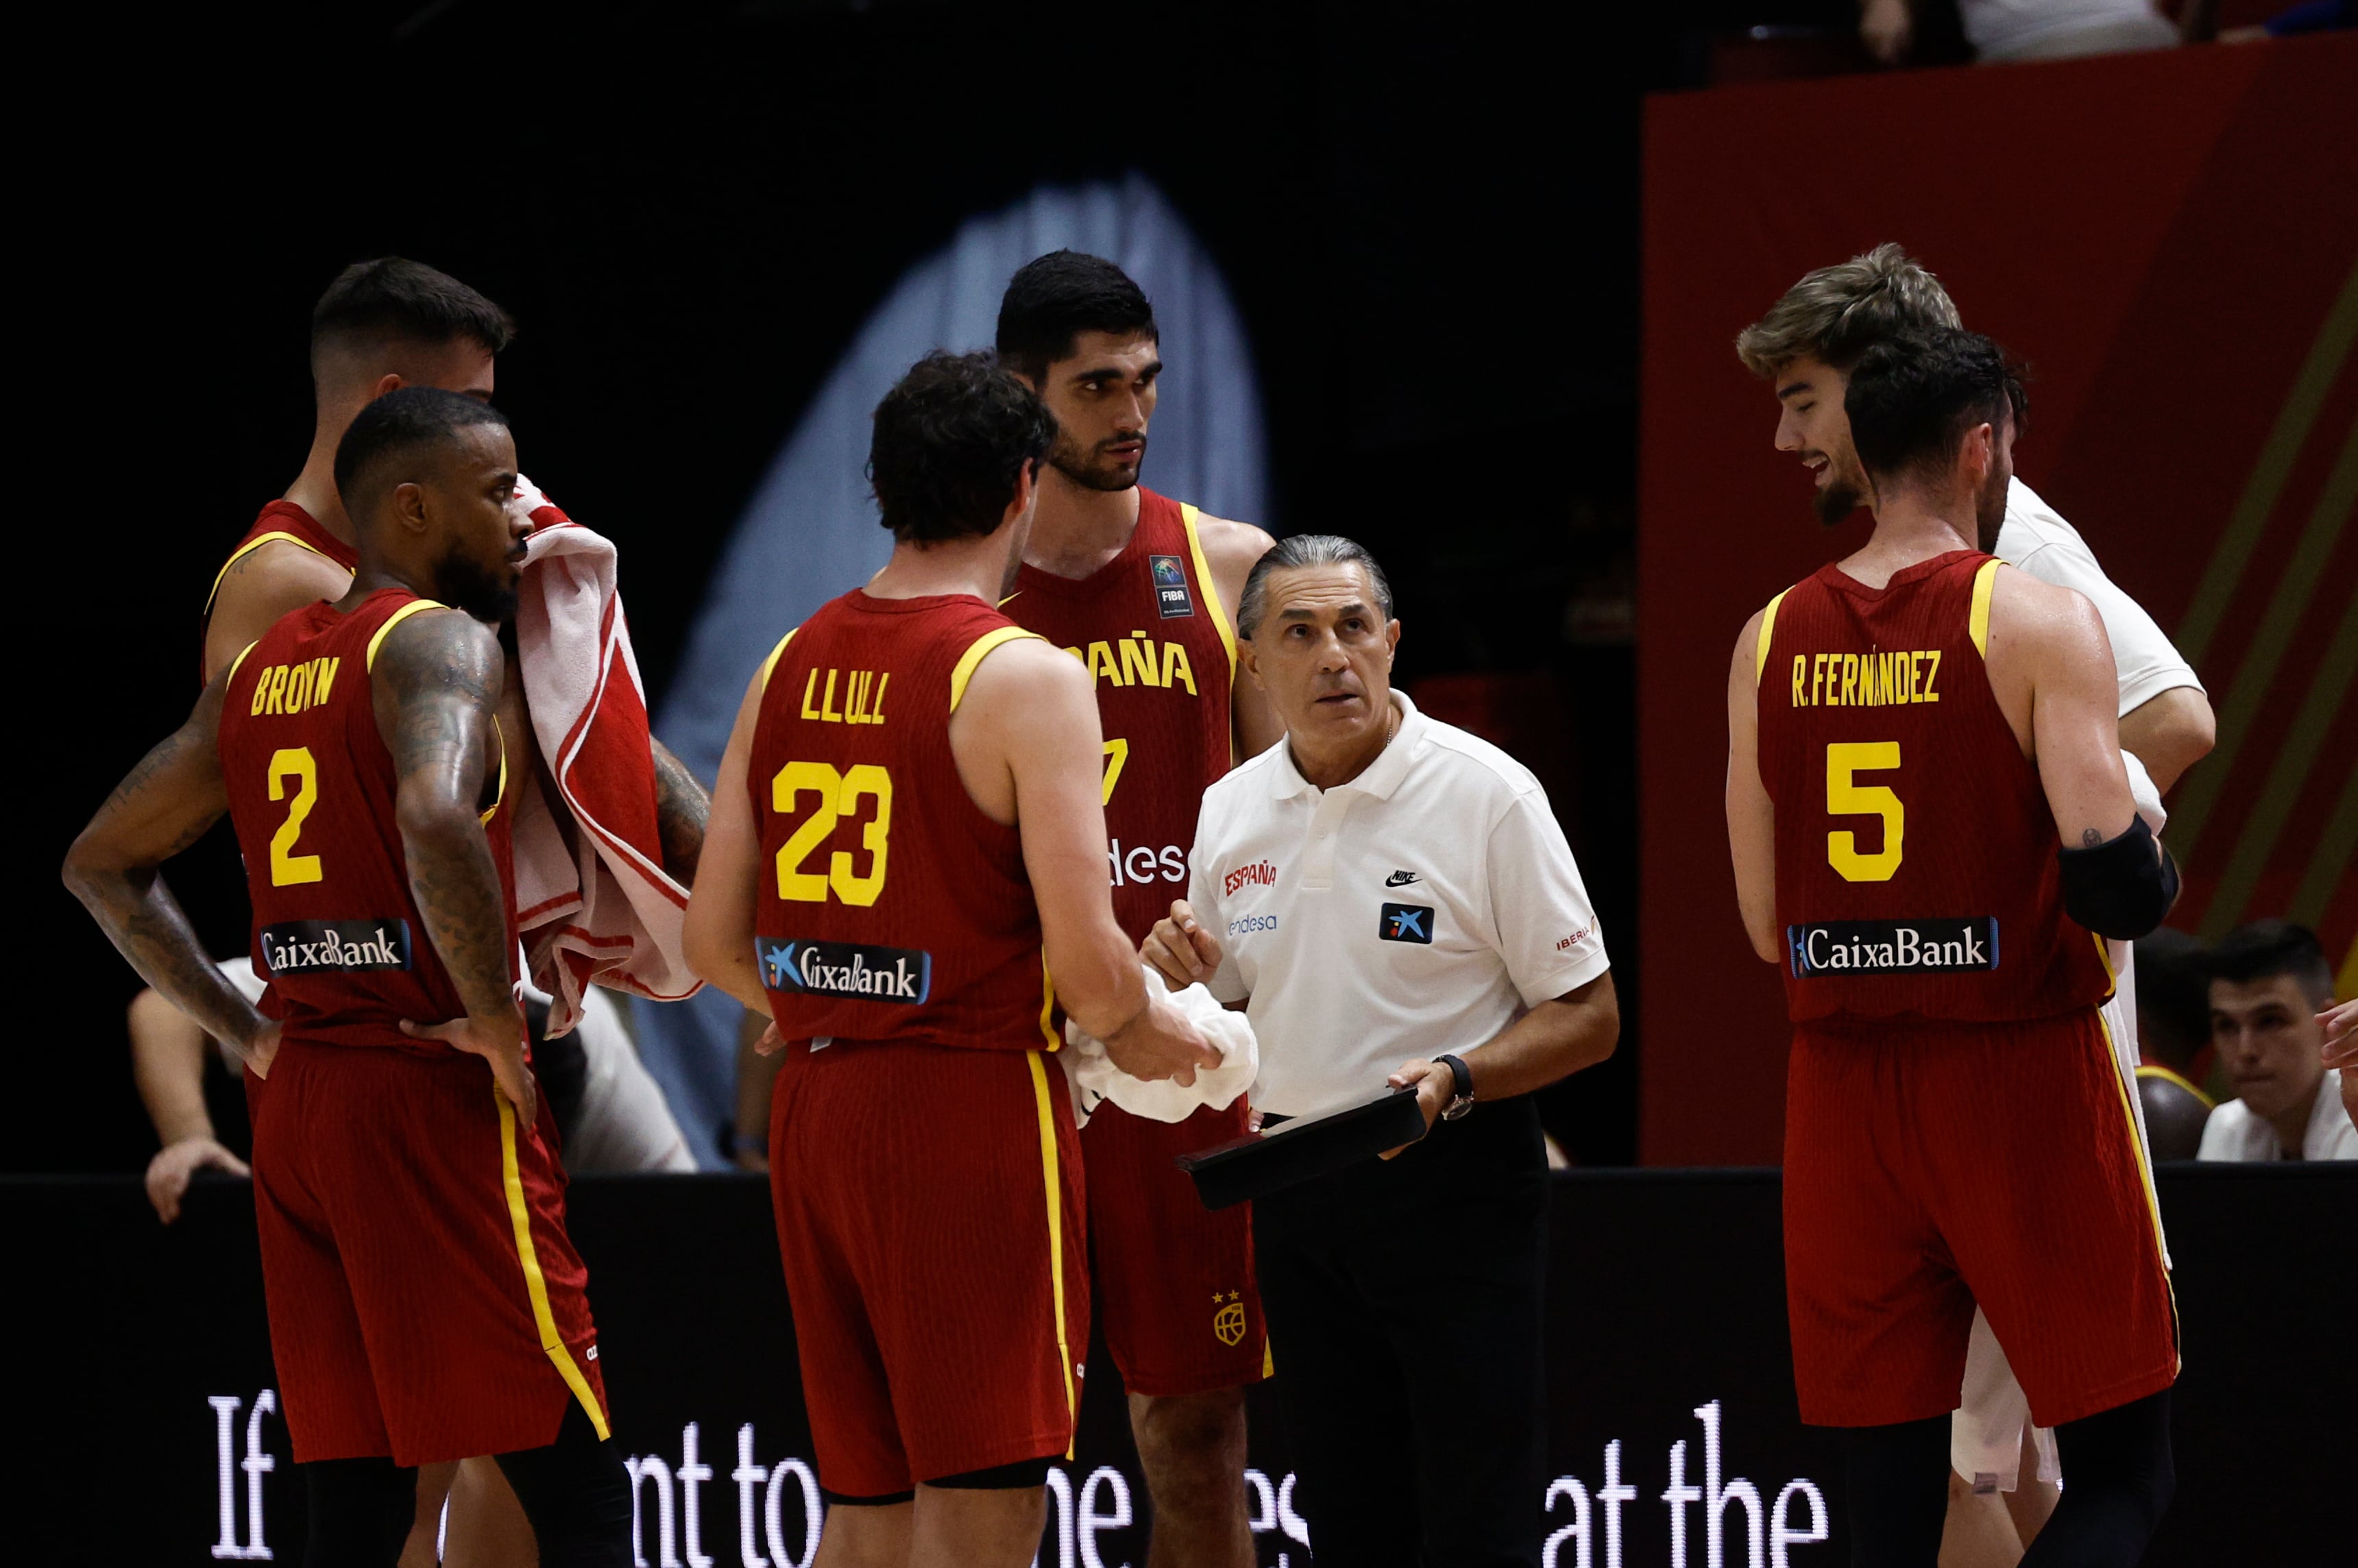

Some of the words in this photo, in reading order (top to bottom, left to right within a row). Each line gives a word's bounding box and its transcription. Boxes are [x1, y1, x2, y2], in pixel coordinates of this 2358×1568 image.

[1162, 590, 1185, 602] FIBA
[1062, 630, 1197, 696] AÑA
[801, 667, 889, 724] LLULL
[268, 746, 322, 886] 2
[772, 761, 892, 907] 23
[1827, 742, 1904, 882] 5
[1225, 859, 1276, 897] ESPAÑA
[1391, 870, 1415, 883] NIKE
[263, 927, 402, 970] CaixaBank
[1229, 914, 1277, 936] endesa
[1557, 926, 1590, 951] IBERIA
[1808, 927, 1987, 970] CaixaBank
[801, 946, 916, 998] CixaBank
[208, 1389, 274, 1560] If
[731, 1422, 823, 1568] to
[1544, 1438, 1637, 1568] at
[1662, 1399, 1829, 1568] the
